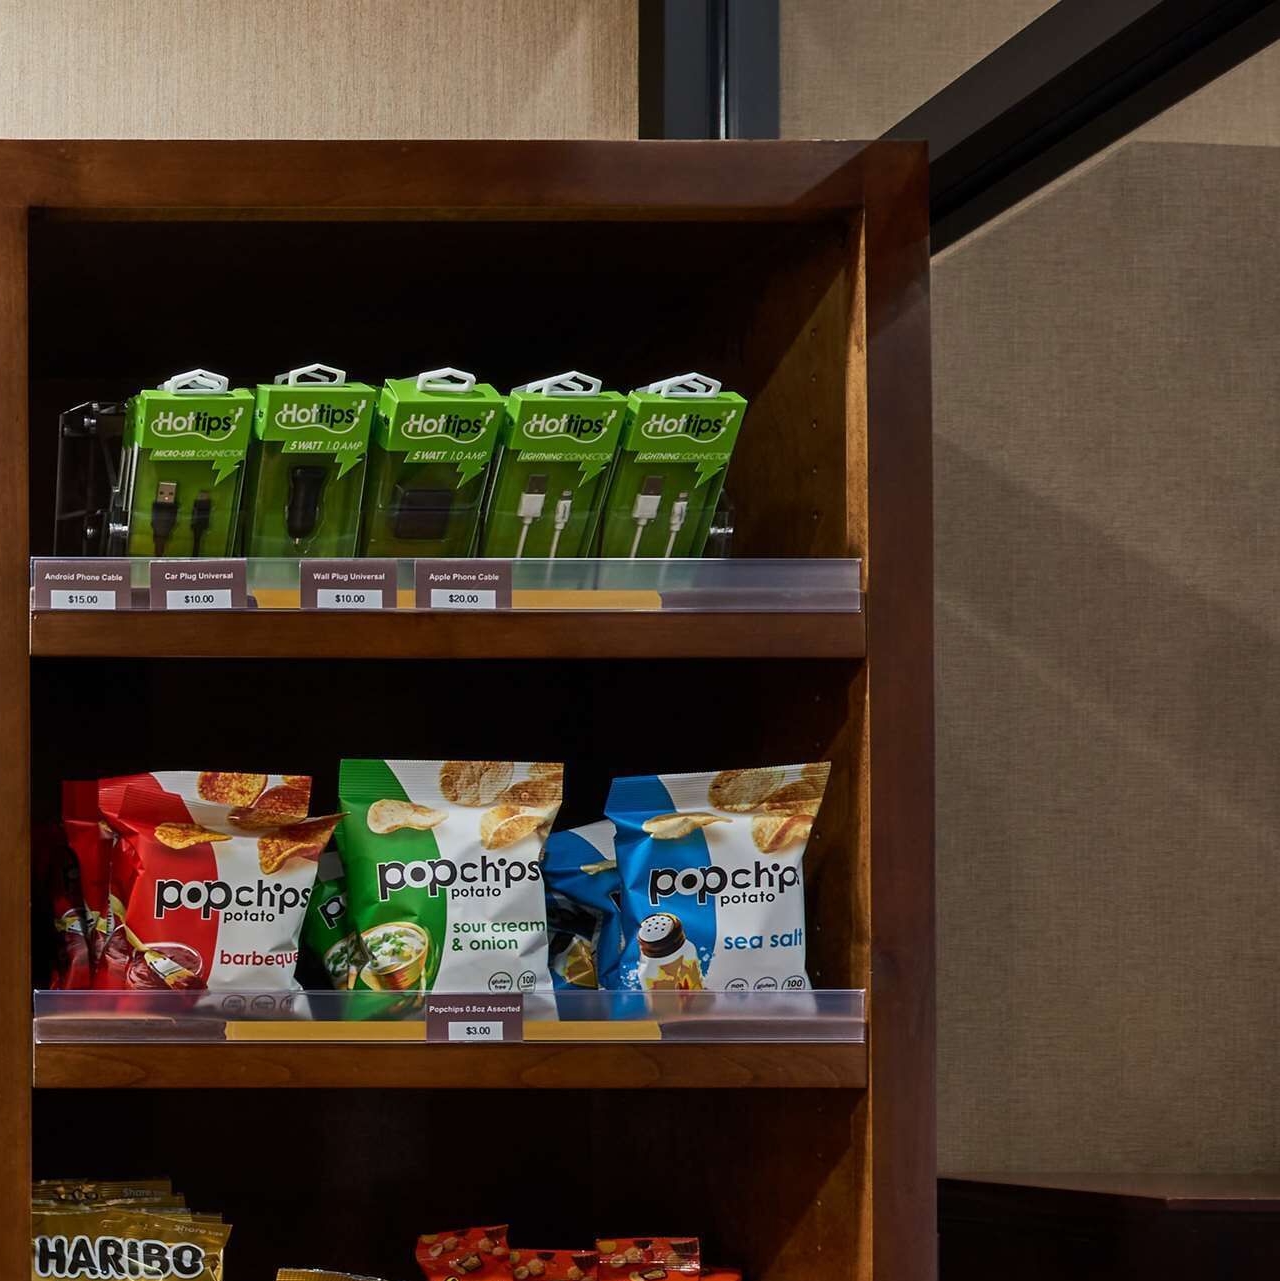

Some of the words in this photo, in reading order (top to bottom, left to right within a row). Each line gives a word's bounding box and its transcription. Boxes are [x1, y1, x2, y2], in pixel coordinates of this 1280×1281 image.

[156, 407, 233, 433] Hottips
[282, 403, 356, 427] Hottips
[530, 413, 604, 434] Hottips
[290, 441, 297, 450] 5
[298, 440, 322, 450] WATT
[325, 440, 340, 450] 1.0
[342, 440, 363, 450] AMP
[45, 573, 75, 581] Android
[76, 573, 100, 581] Phone
[68, 594, 98, 604] $15.00
[378, 856, 539, 901] popchips
[451, 885, 501, 898] potato
[721, 891, 776, 907] potato
[154, 879, 313, 920] popchips
[223, 910, 275, 924] potato
[452, 920, 486, 932] sour
[490, 918, 545, 932] cream
[452, 937, 465, 951] &
[470, 936, 519, 951] onion
[724, 932, 764, 950] sea
[769, 928, 802, 947] salt
[220, 950, 302, 966] barbeque
[430, 1005, 463, 1015] Popchips
[465, 1006, 486, 1014] 0.8oz
[487, 1005, 520, 1013] Assorted
[465, 1025, 491, 1035] $3.00
[36, 1236, 204, 1278] HARIBO
